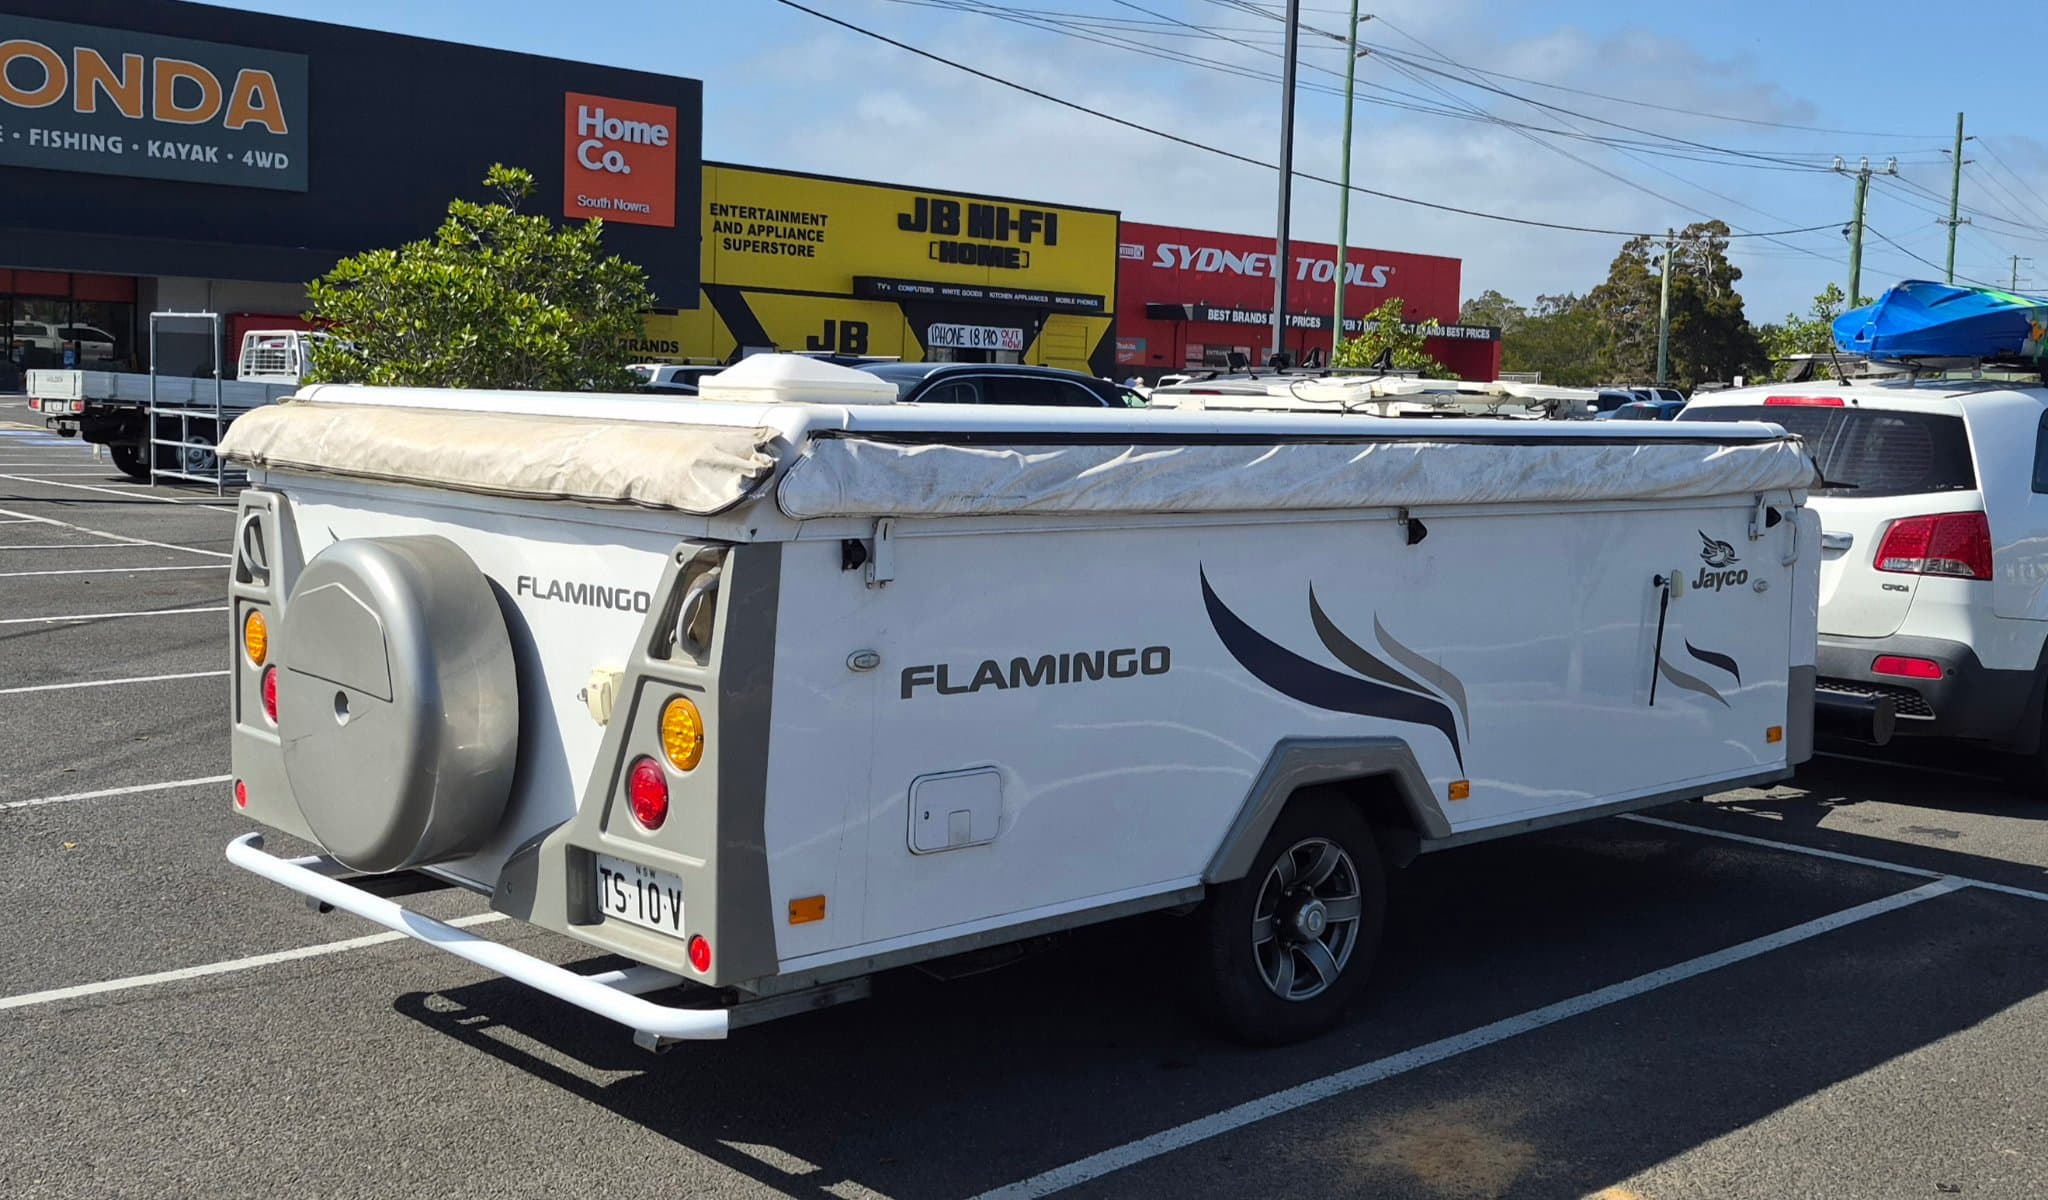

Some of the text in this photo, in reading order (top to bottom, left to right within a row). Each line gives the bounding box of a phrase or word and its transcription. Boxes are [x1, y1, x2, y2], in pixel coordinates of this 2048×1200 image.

[578, 104, 669, 147] Home
[29, 128, 123, 154] FISHING
[147, 140, 219, 163] KAYAK
[242, 151, 289, 170] 4WD
[577, 139, 631, 175] Co.
[577, 195, 650, 213] South Nowra
[710, 203, 828, 227] ENTERTAINMENT
[713, 220, 824, 242] AND APPLIANCE
[897, 197, 1057, 246] JB HI-FI
[723, 237, 815, 258] SUPERSTORE
[897, 284, 934, 294] COMPUTERS
[941, 288, 961, 296] WHITE
[1208, 308, 1230, 321] BEST
[1232, 310, 1267, 324] BRANDS
[1291, 315, 1321, 328] PRICES
[1357, 320, 1362, 331] 7
[806, 319, 869, 355] JB
[931, 325, 966, 345] IPHONE
[1446, 327, 1465, 338] BEST
[1466, 328, 1490, 339] PRICES
[1692, 567, 1748, 592] Jayco
[517, 575, 651, 614] FLAMINGO
[901, 646, 1171, 700] FLAMINGO
[636, 864, 657, 879] NSW
